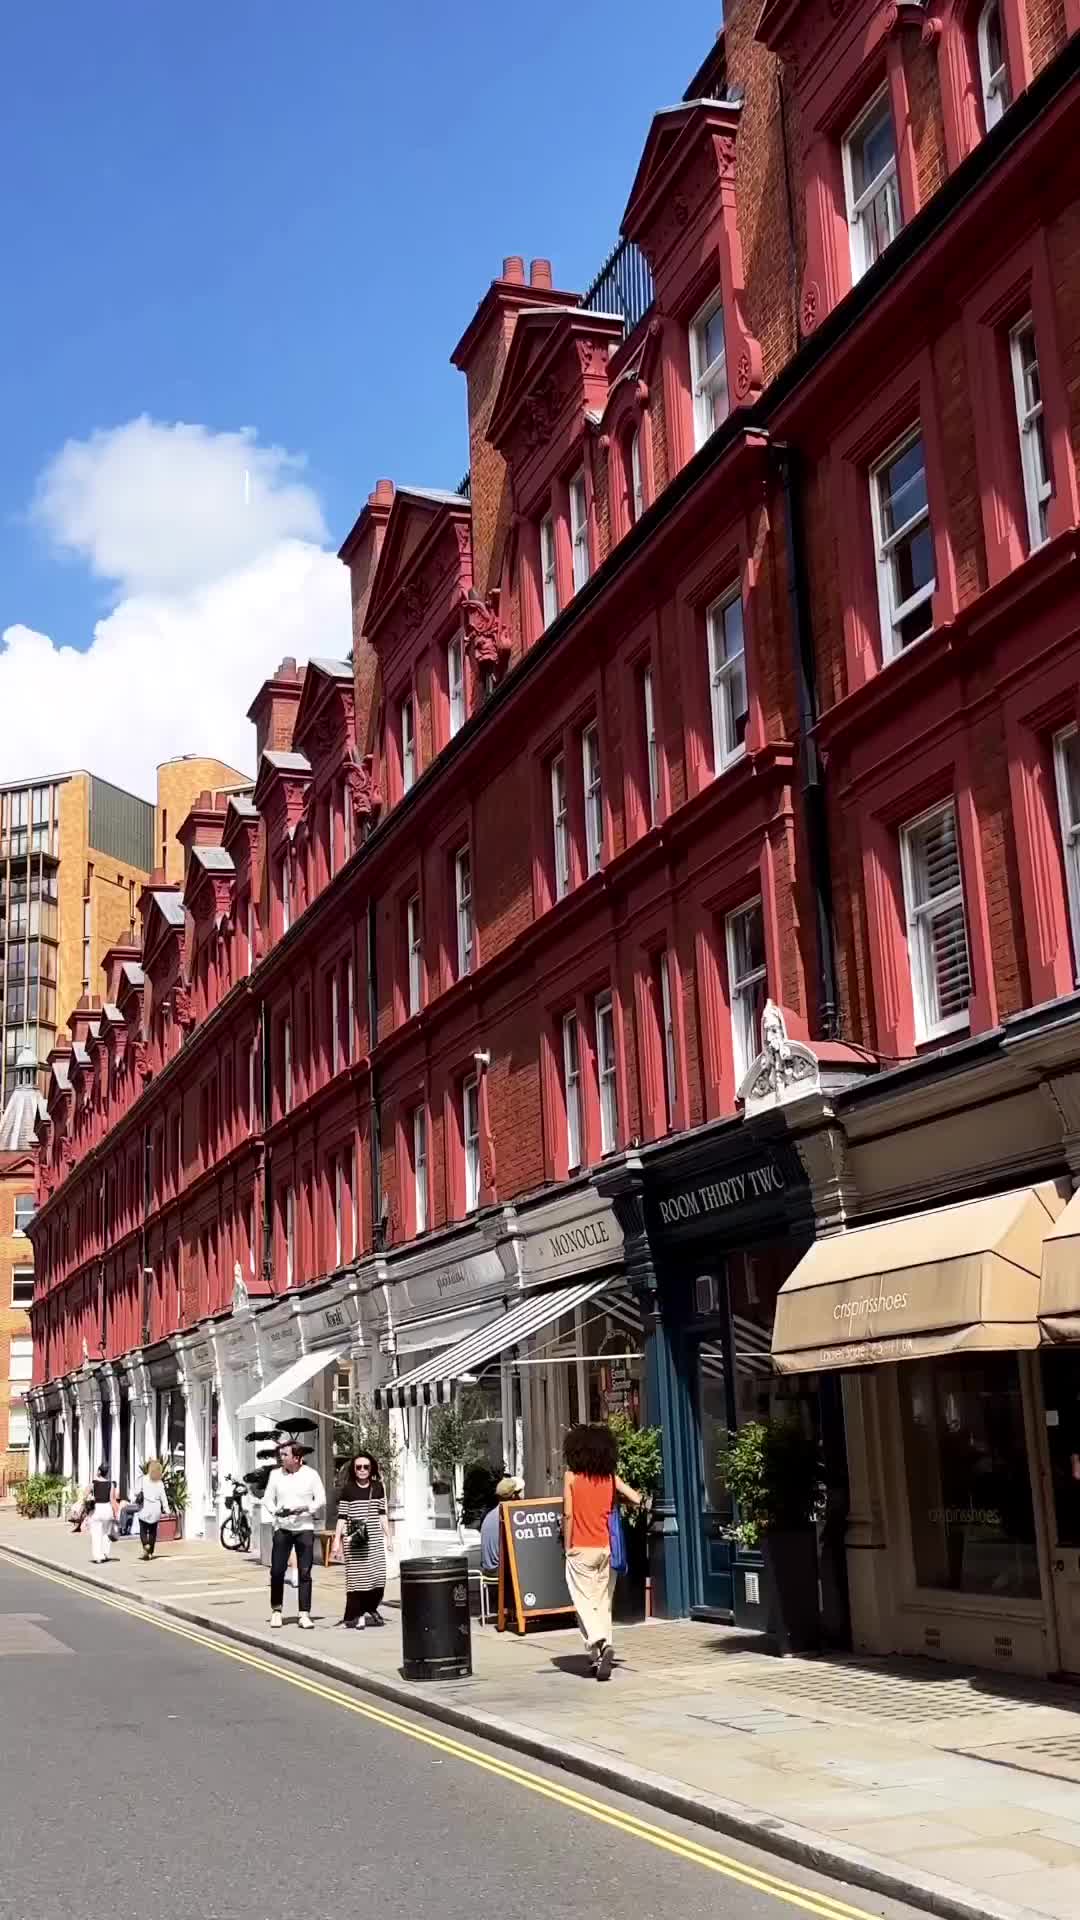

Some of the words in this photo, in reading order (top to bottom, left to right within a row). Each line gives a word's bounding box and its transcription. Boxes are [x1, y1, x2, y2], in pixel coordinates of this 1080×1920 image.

[659, 1191, 700, 1224] ROOM
[699, 1173, 746, 1211] THIRTY
[748, 1164, 785, 1196] TWO
[549, 1220, 610, 1258] MONOCLE
[513, 1510, 556, 1525] Come
[515, 1528, 534, 1540] on
[537, 1524, 552, 1538] in
